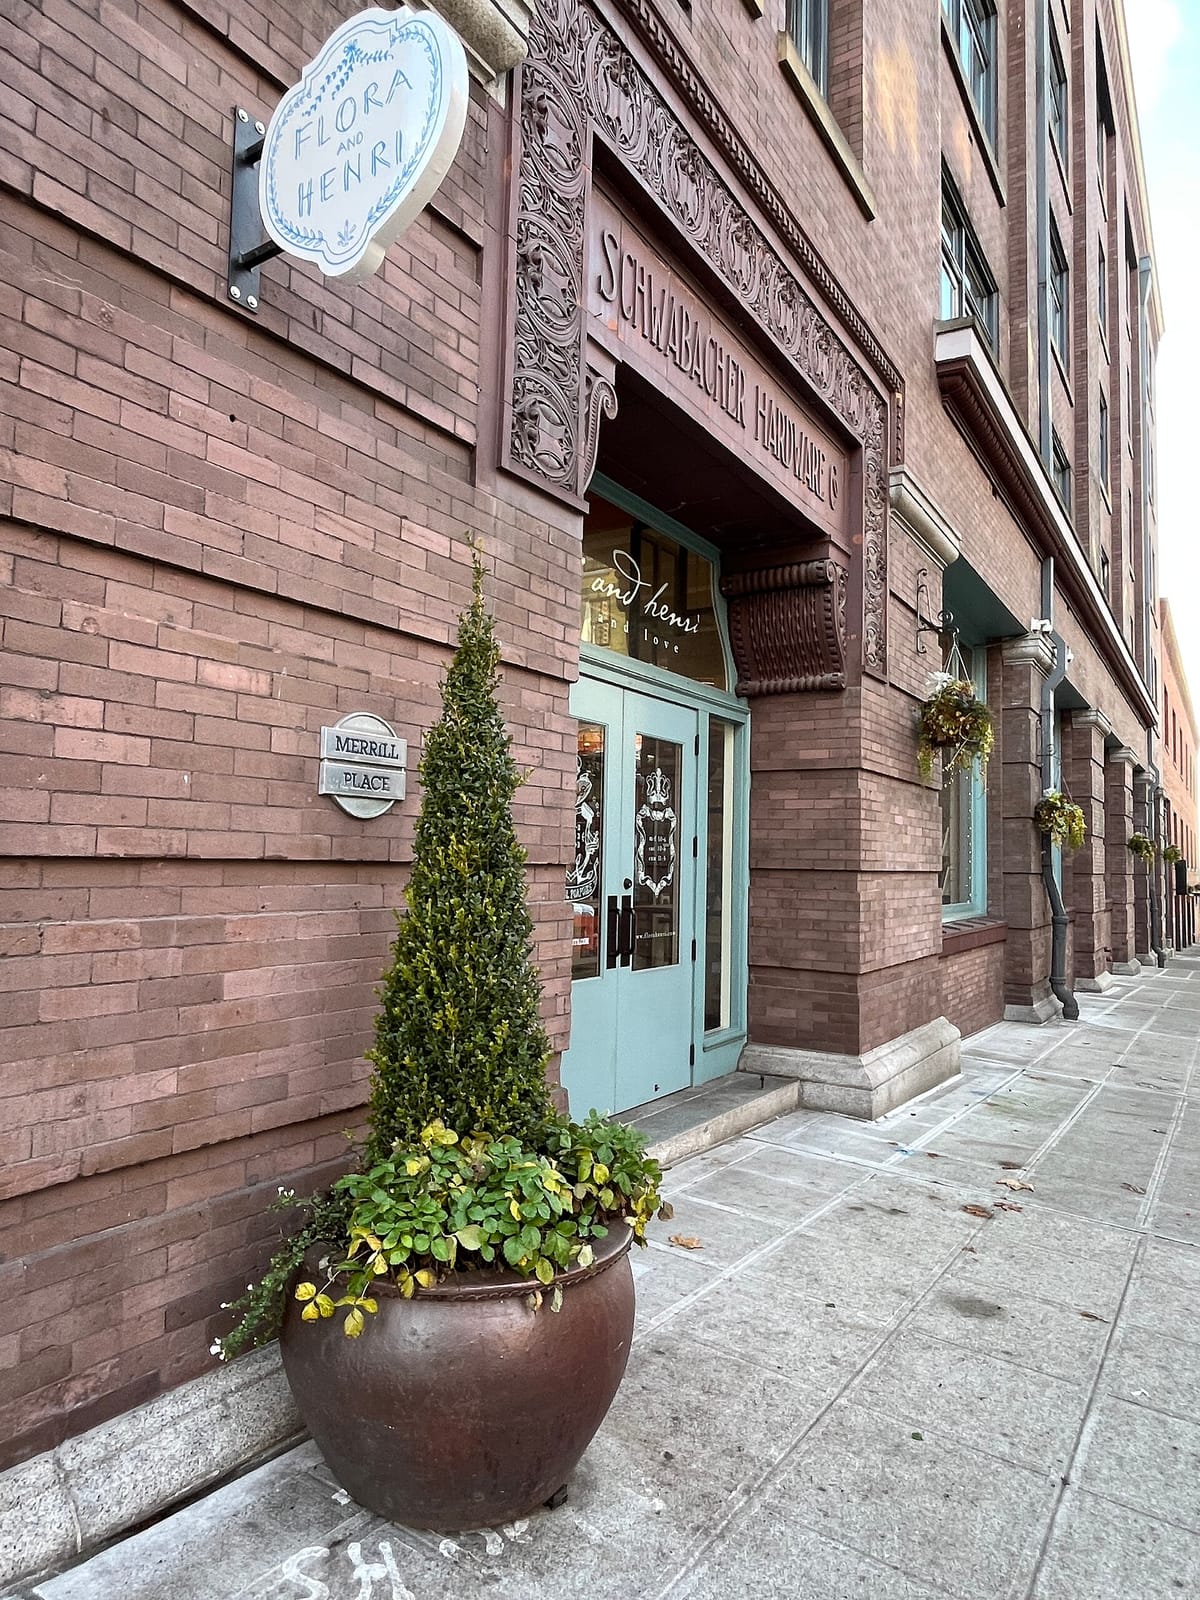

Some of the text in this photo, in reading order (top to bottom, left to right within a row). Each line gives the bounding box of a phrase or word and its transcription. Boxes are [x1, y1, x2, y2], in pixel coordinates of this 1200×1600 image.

[294, 69, 413, 160] FLORA
[336, 131, 364, 156] AND
[298, 129, 403, 217] HENRI
[598, 228, 747, 429] SCHWABACHER
[754, 385, 825, 502] HARDWARE
[591, 549, 701, 634] and henri
[597, 613, 679, 653] and love
[335, 735, 399, 760] MERRILL
[343, 772, 390, 791] PLACE
